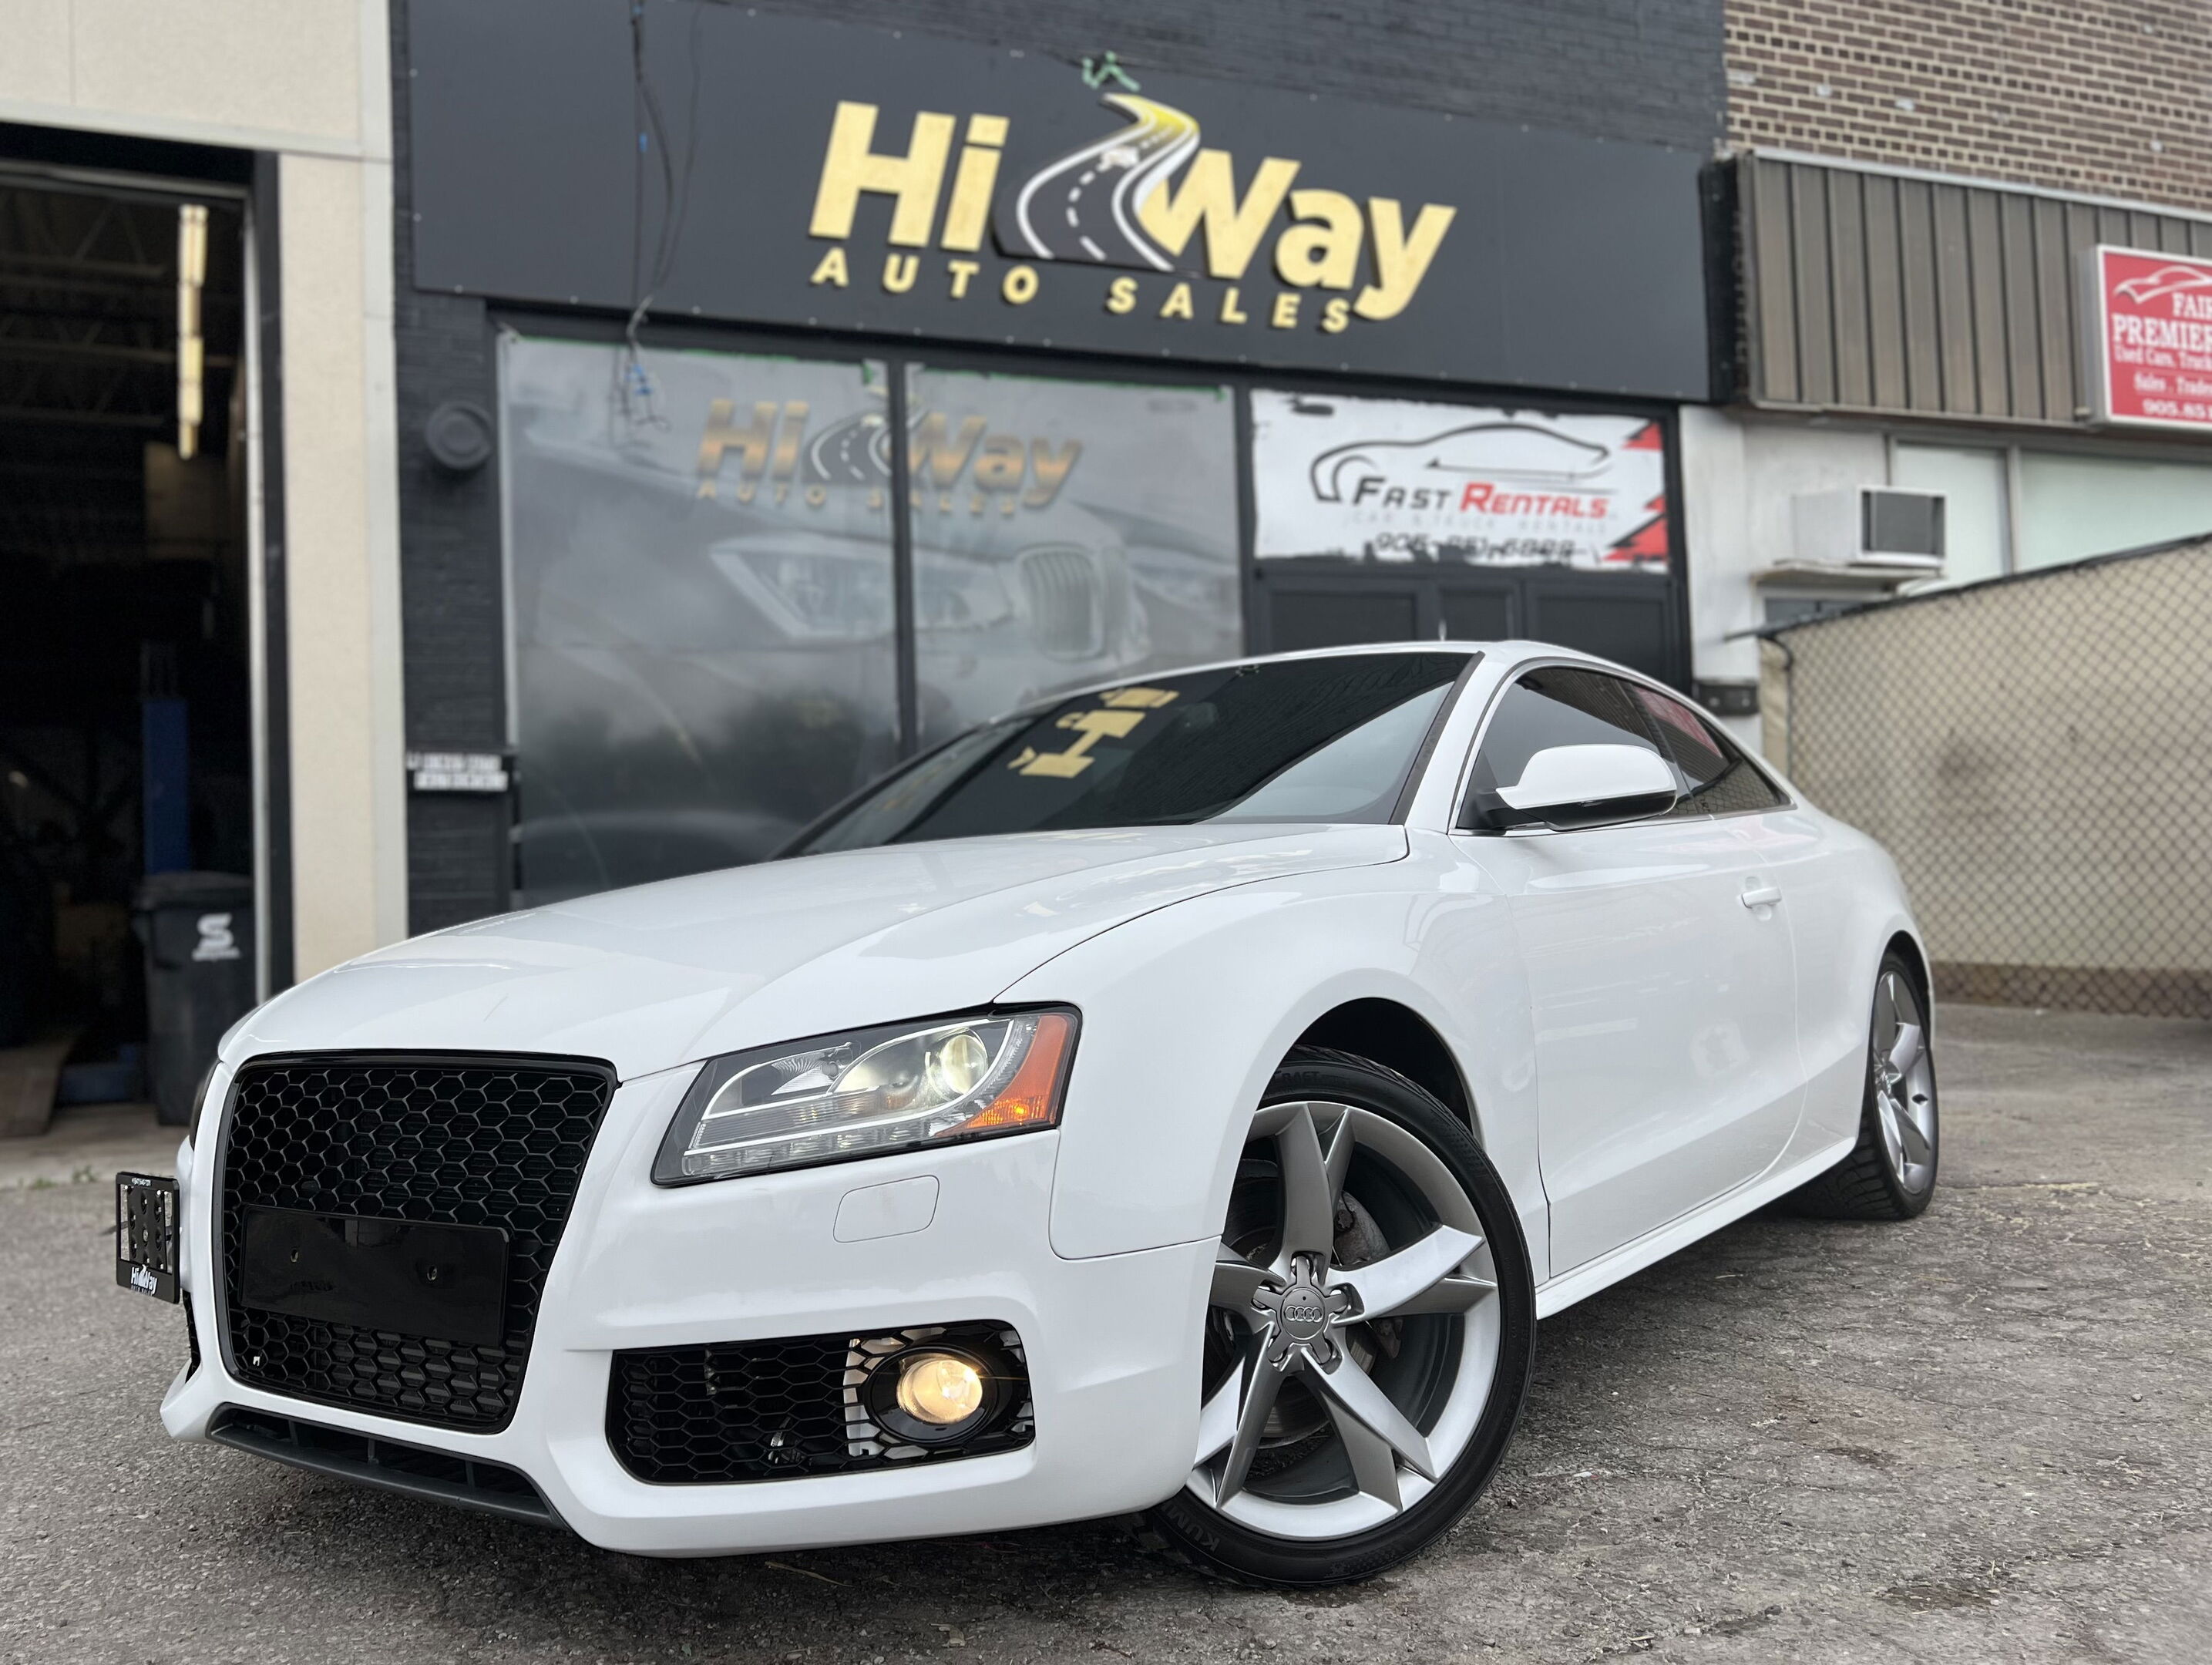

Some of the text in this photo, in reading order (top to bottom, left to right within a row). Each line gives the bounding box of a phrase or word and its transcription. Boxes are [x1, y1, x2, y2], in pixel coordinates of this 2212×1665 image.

[810, 247, 1350, 332] AUTO SALES
[697, 480, 828, 507] AUTO
[1352, 476, 1608, 519] FAST RENTALS
